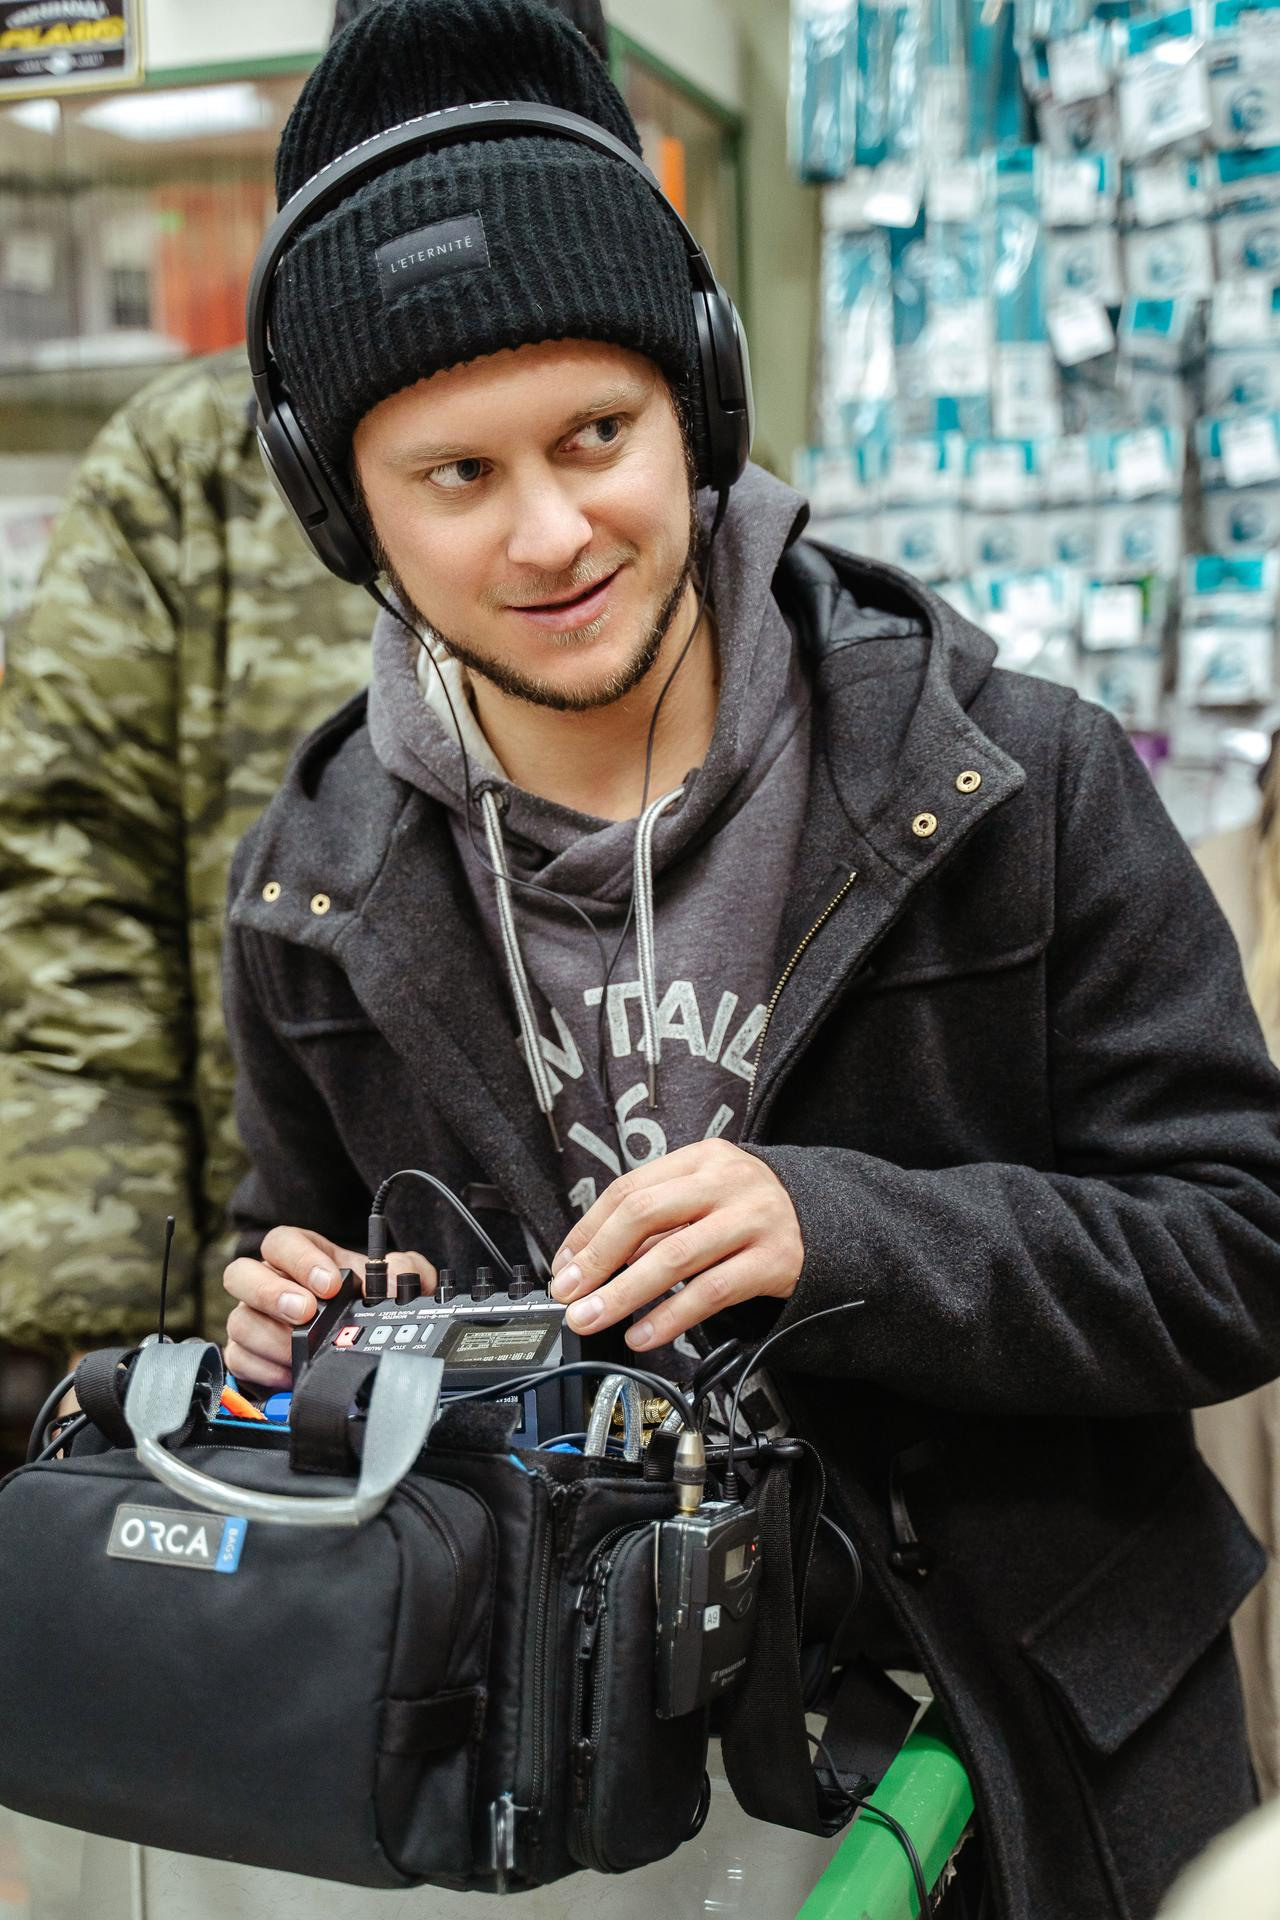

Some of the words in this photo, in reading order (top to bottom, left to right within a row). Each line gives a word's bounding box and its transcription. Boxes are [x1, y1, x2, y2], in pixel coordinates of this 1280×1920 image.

[121, 1518, 209, 1557] ORCA
[223, 1528, 238, 1561] BAGS
[706, 1611, 718, 1625] A9
